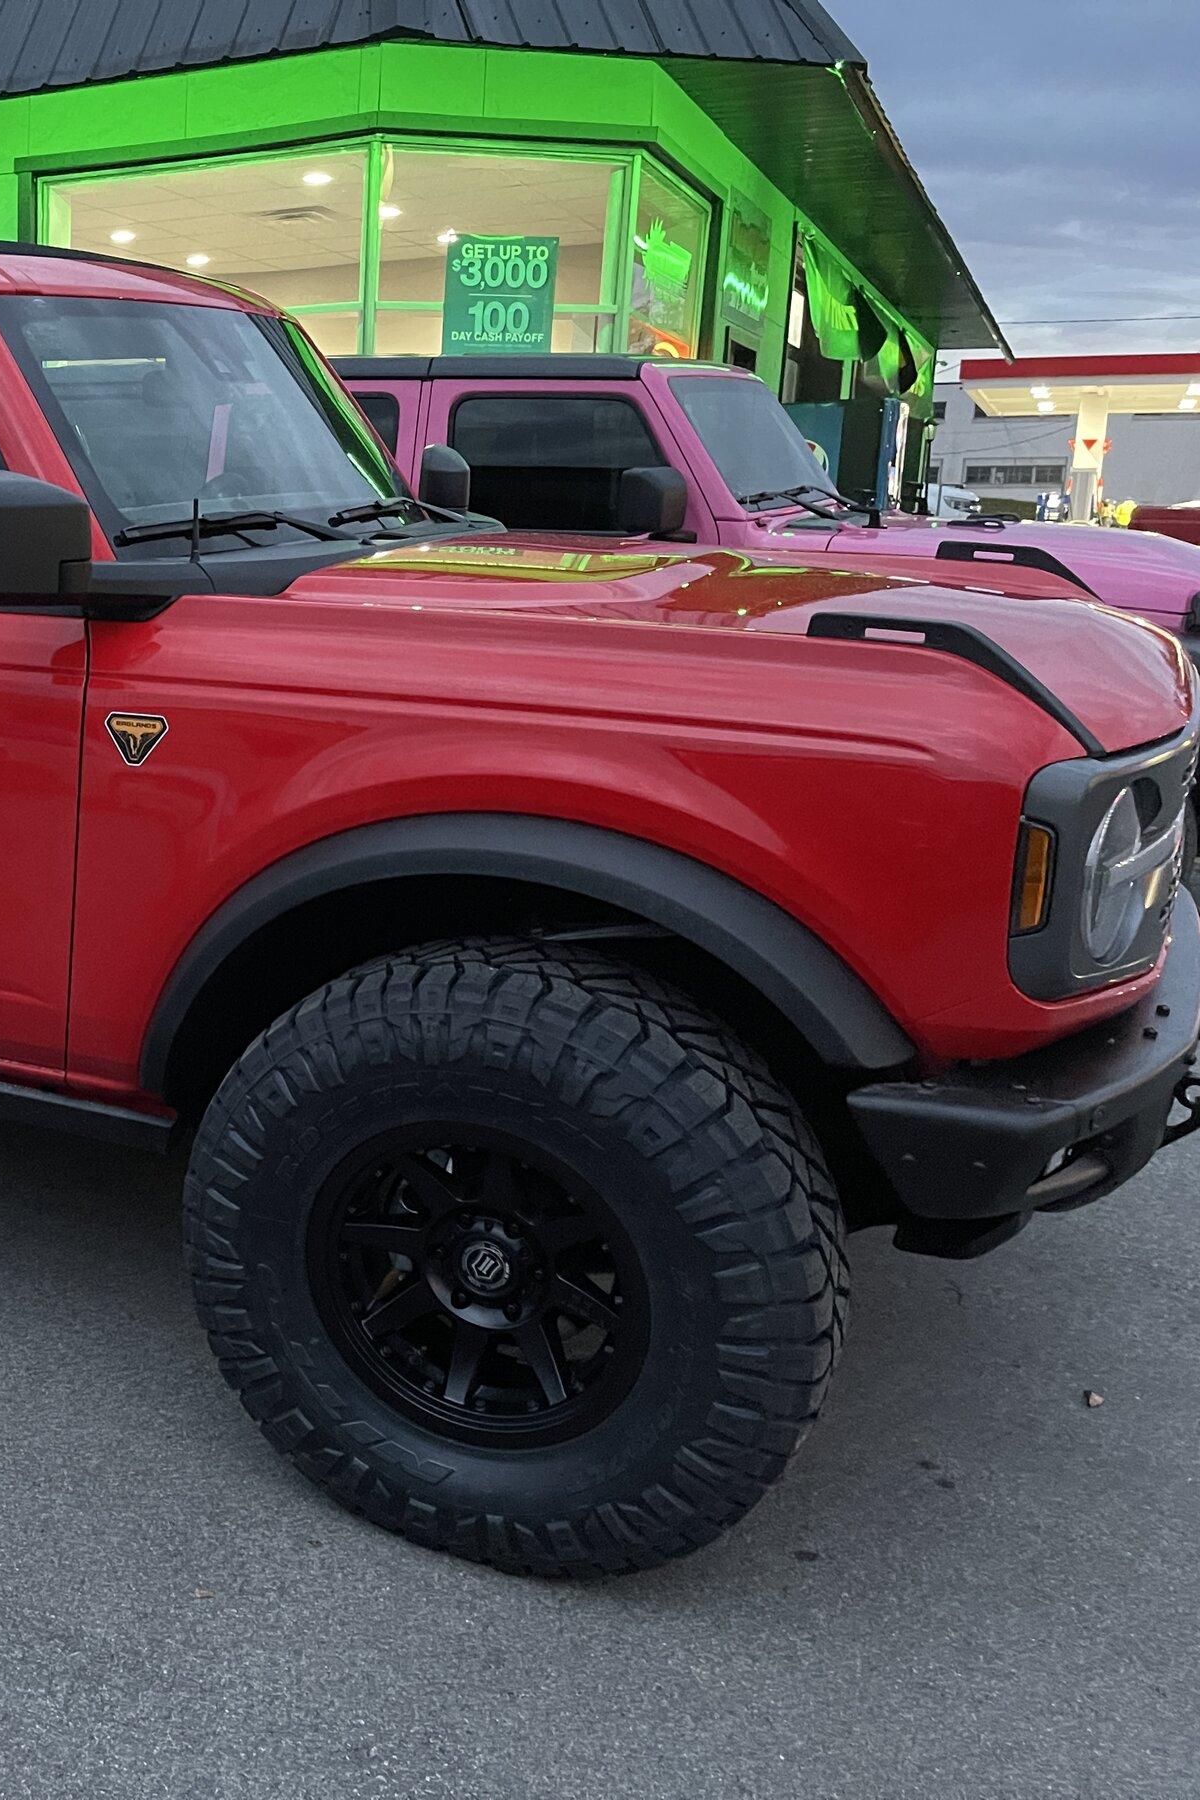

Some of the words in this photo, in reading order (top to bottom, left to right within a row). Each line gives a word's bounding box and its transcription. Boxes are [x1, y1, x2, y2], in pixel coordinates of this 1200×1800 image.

[461, 243, 495, 258] GET
[500, 245, 522, 260] UP
[525, 245, 549, 260] TO
[452, 256, 548, 290] $3,000
[468, 301, 530, 335] 100
[451, 331, 472, 341] DAY
[474, 332, 502, 342] CASH
[505, 333, 544, 343] PAYOFF
[116, 720, 157, 729] BADLANDS
